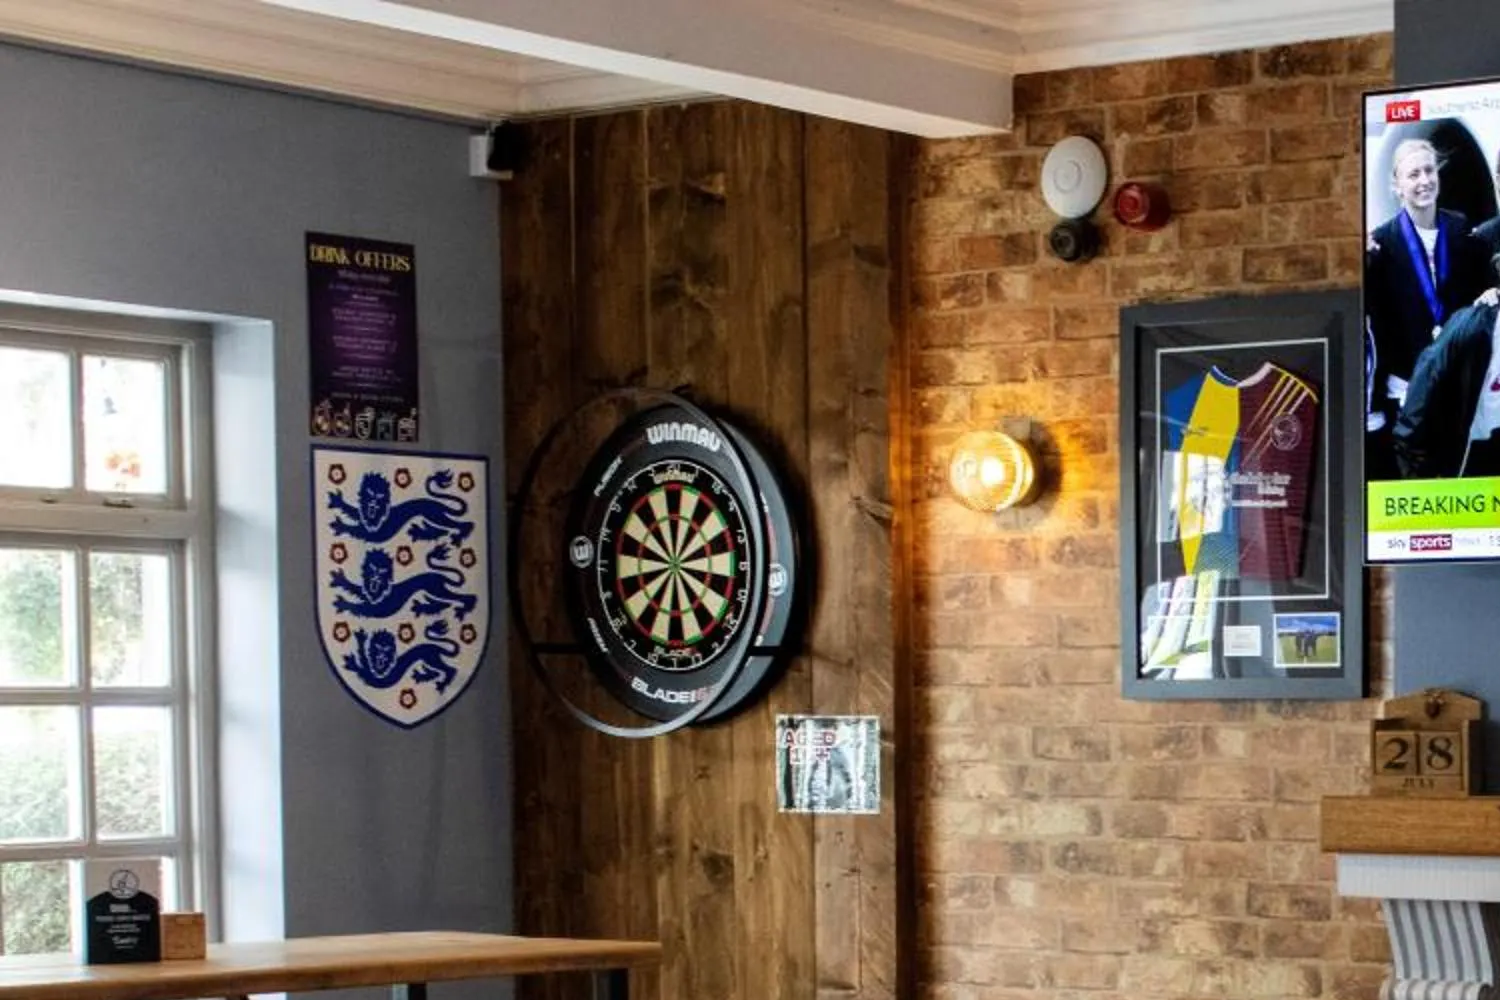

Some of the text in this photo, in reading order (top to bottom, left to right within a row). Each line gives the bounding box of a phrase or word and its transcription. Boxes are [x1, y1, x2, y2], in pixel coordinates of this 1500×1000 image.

[1390, 105, 1416, 119] LIVE
[646, 421, 721, 452] WINMAU
[1385, 495, 1485, 516] BREAKING
[1411, 535, 1453, 550] sports
[1382, 735, 1453, 771] 28
